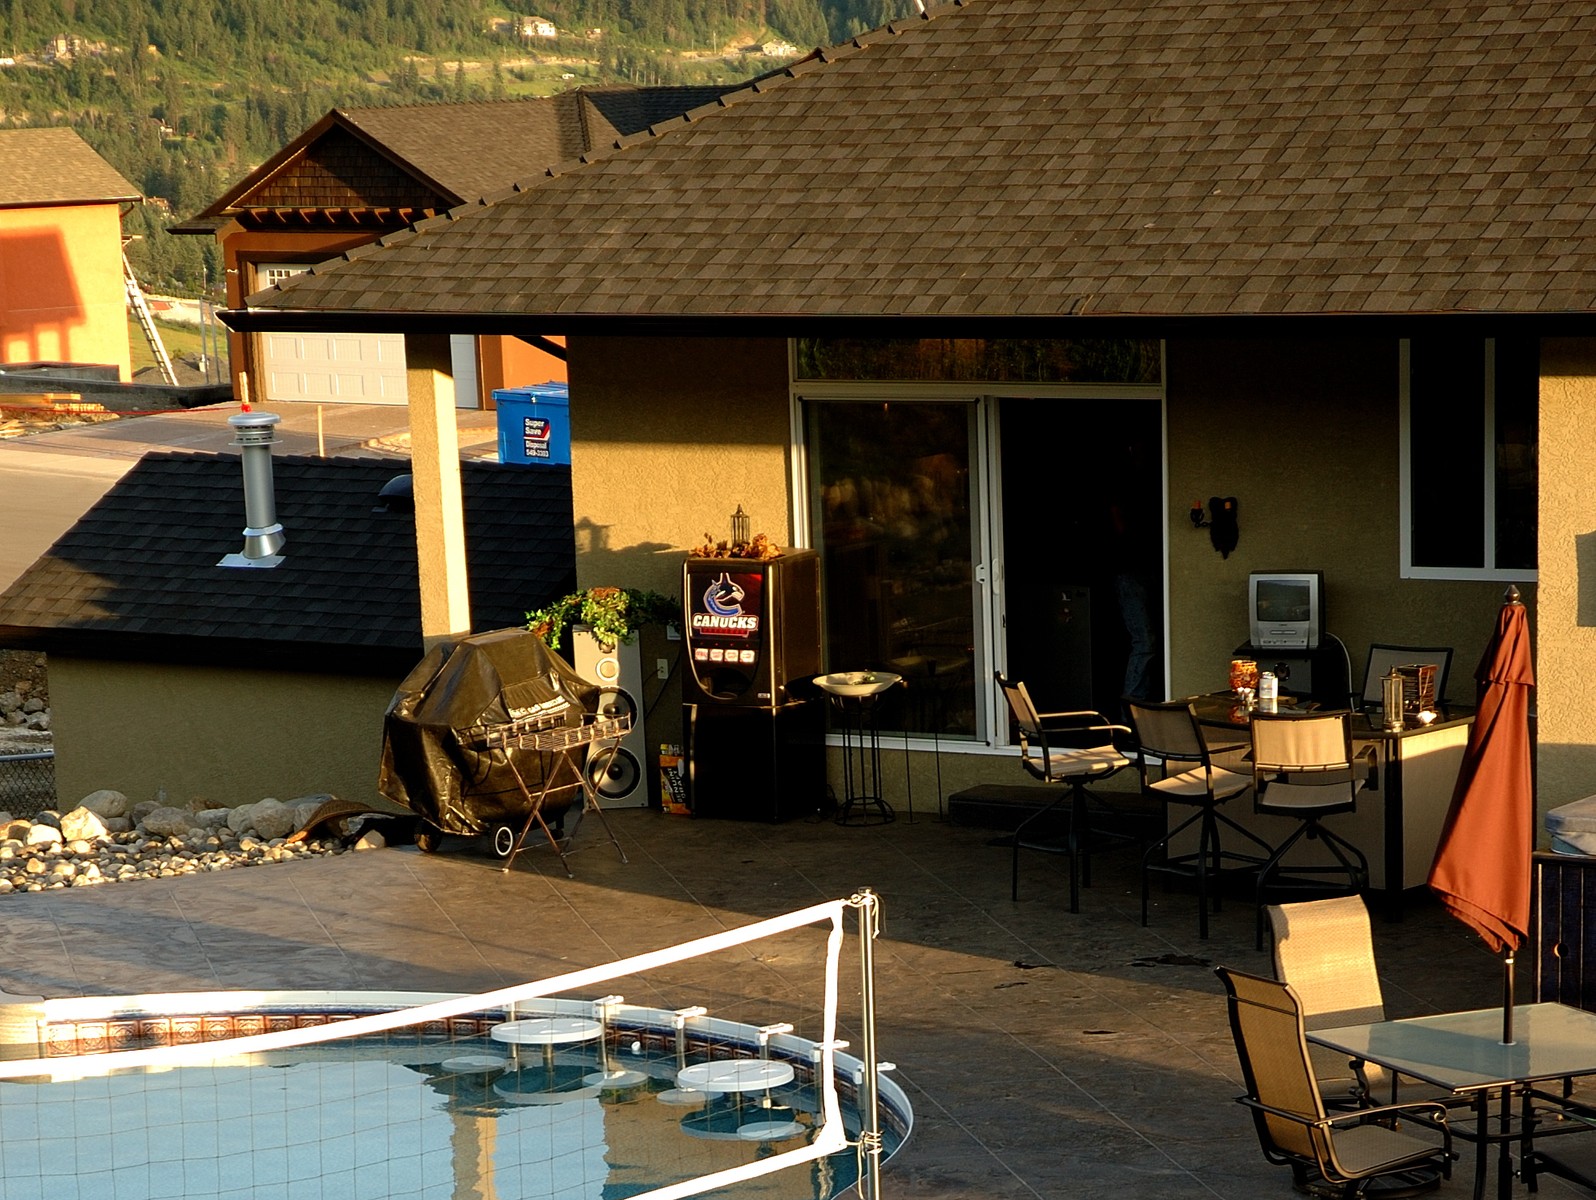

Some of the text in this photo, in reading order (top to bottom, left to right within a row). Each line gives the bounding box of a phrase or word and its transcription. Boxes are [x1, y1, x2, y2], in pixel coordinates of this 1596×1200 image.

[525, 418, 544, 428] Super
[525, 427, 542, 435] Save
[526, 440, 546, 449] Disposal
[692, 614, 757, 628] CANUCKS
